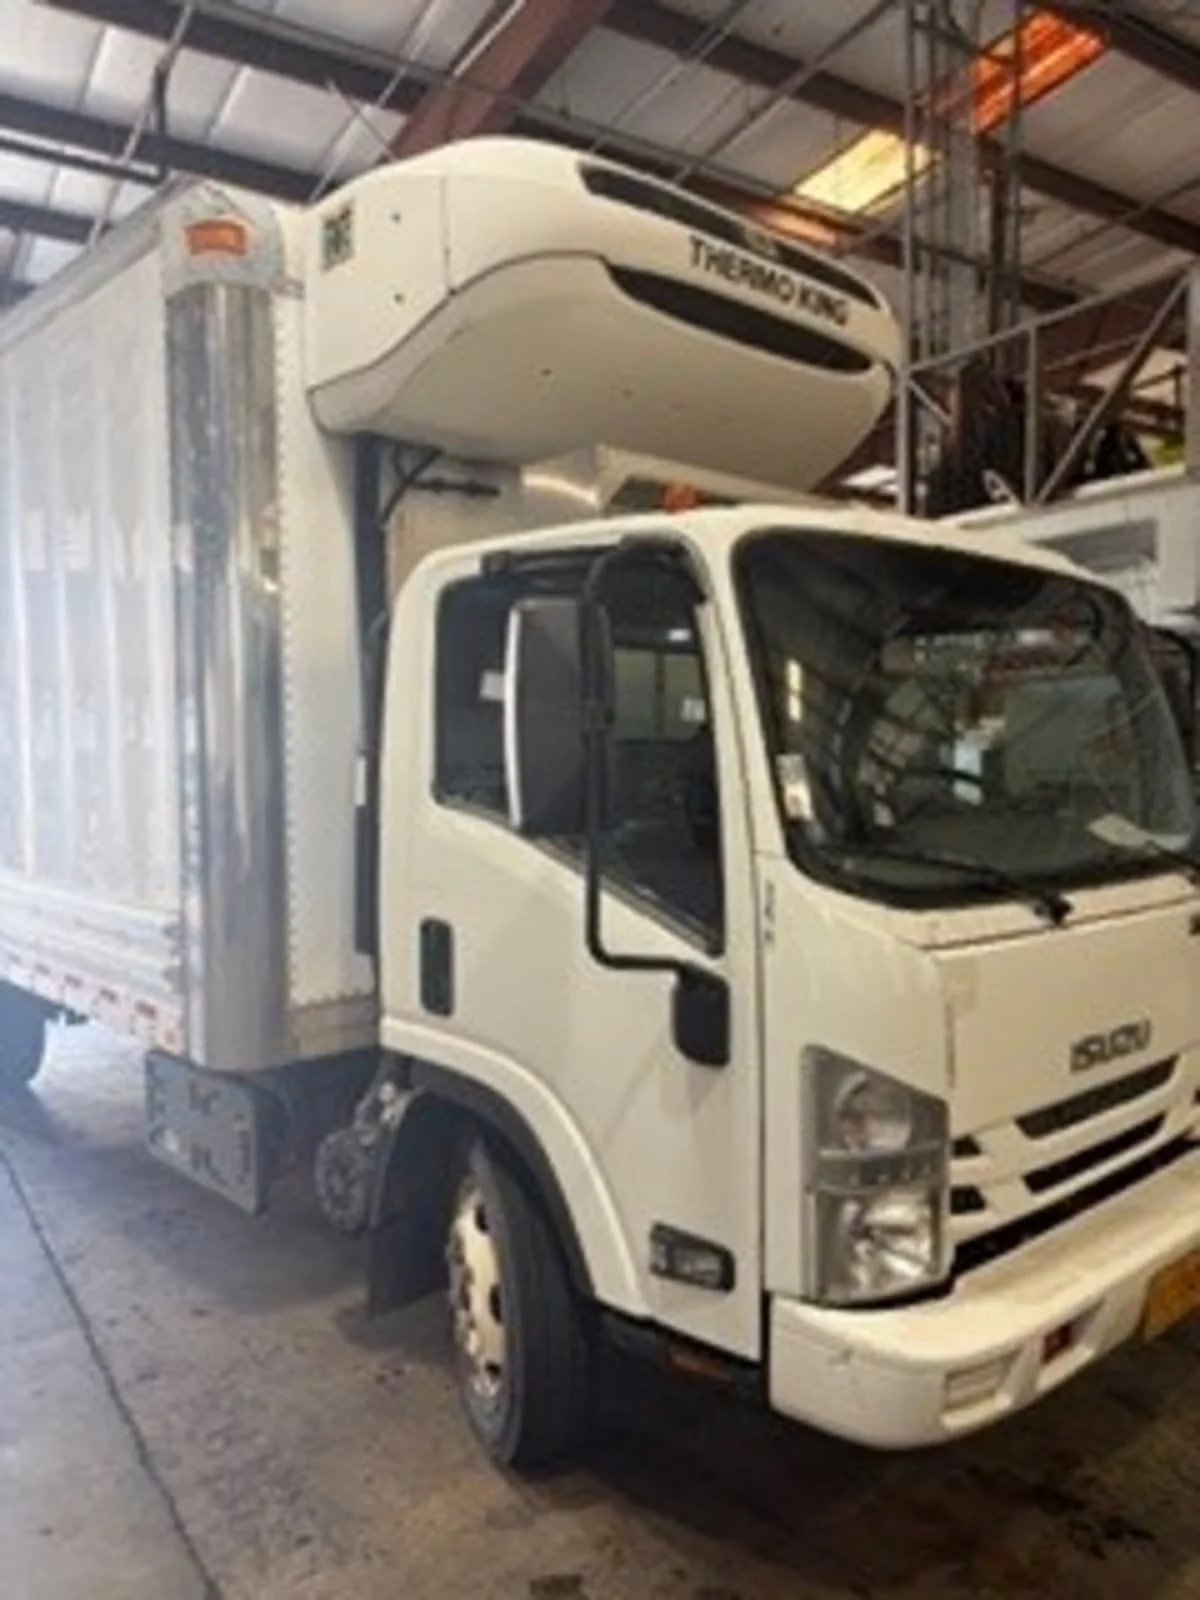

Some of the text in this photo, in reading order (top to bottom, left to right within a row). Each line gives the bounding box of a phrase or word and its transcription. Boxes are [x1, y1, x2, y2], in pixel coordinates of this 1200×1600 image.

[690, 234, 850, 327] THERMO KING
[1070, 1019, 1152, 1074] ISUZU
